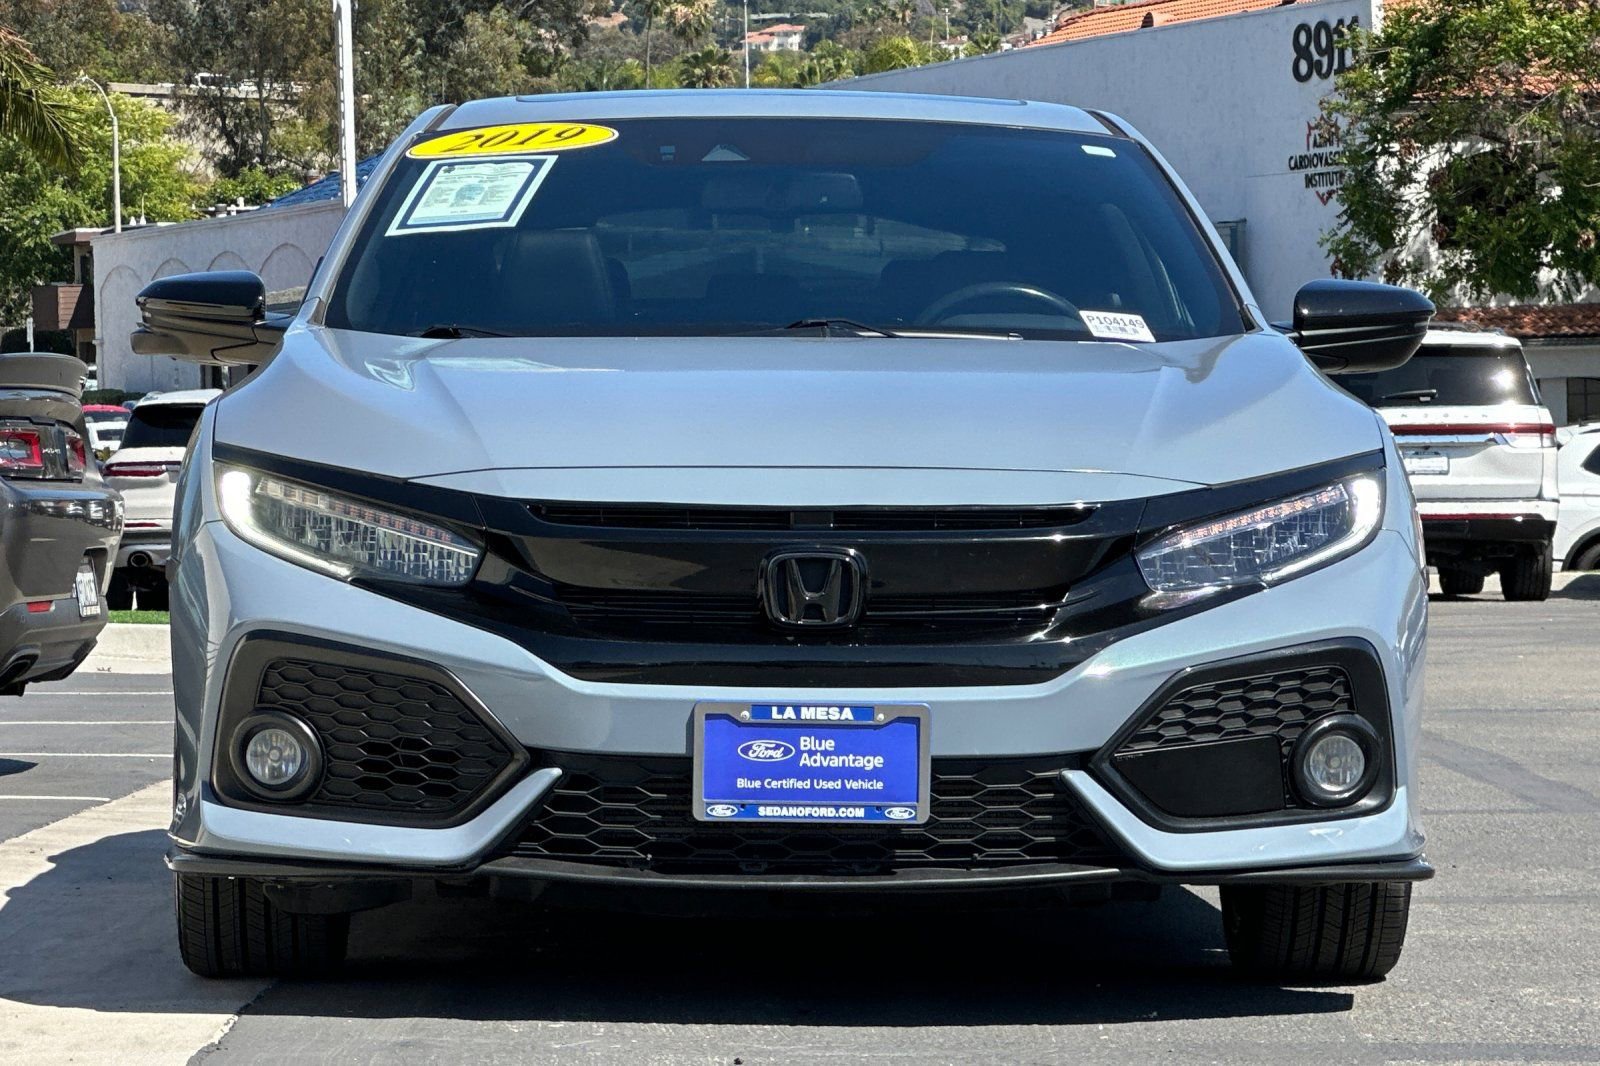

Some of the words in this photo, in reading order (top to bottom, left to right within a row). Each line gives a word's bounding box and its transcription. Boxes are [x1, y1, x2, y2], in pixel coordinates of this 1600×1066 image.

[438, 126, 587, 153] 2019
[1288, 150, 1344, 170] CARDIOVASC
[1086, 315, 1145, 328] P104149
[771, 706, 796, 719] LA
[800, 706, 854, 720] MESA
[748, 742, 784, 758] Ford
[800, 736, 835, 751] Blue
[799, 752, 884, 770] Advantage
[736, 778, 761, 788] Blue
[764, 778, 810, 789] Certified
[814, 779, 841, 789] Used
[844, 779, 884, 790] Vehicle
[758, 806, 864, 818] SEDANOFORD.COM
